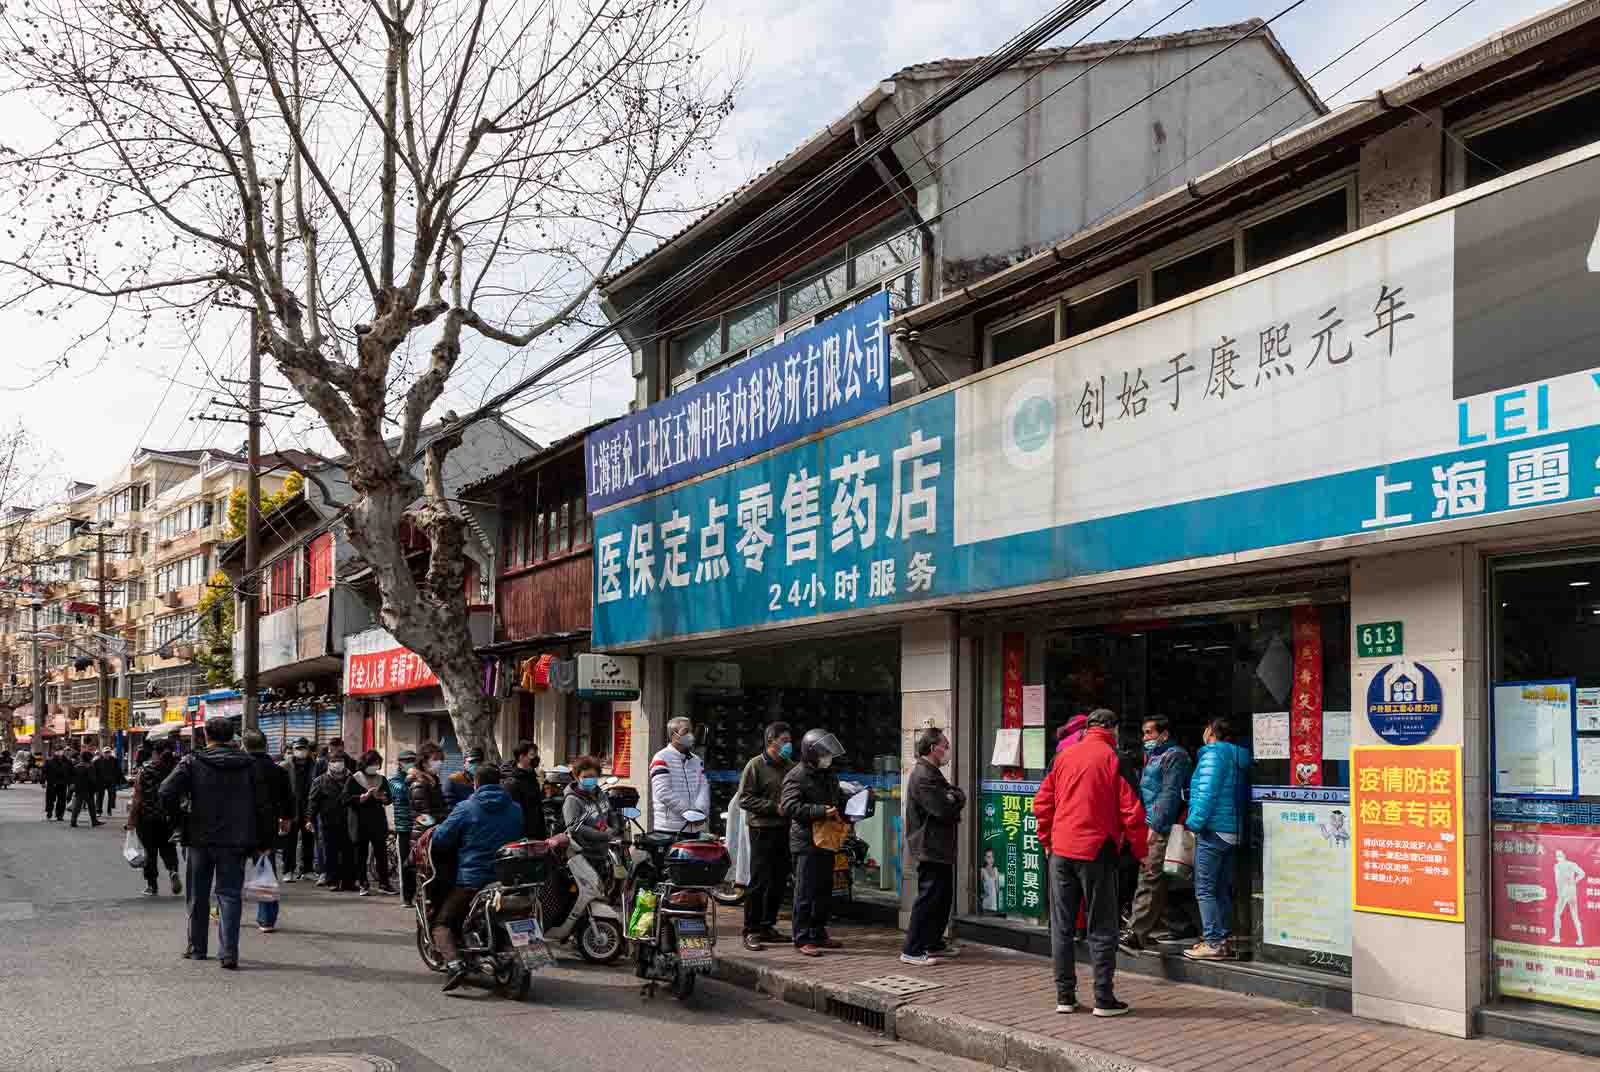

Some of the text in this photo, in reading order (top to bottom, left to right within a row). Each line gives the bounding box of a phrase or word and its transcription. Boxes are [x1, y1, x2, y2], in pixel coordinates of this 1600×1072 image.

[1074, 285, 1416, 431] 创始于康熙元年
[1458, 384, 1549, 446] LEI
[1361, 442, 1600, 528] 上海雷
[597, 430, 942, 605] 医保定点零售药店
[768, 550, 937, 611] 24小时服务
[1363, 626, 1396, 645] 613
[1359, 766, 1452, 794] 疫情防控
[1359, 799, 1452, 829] 检查专岗
